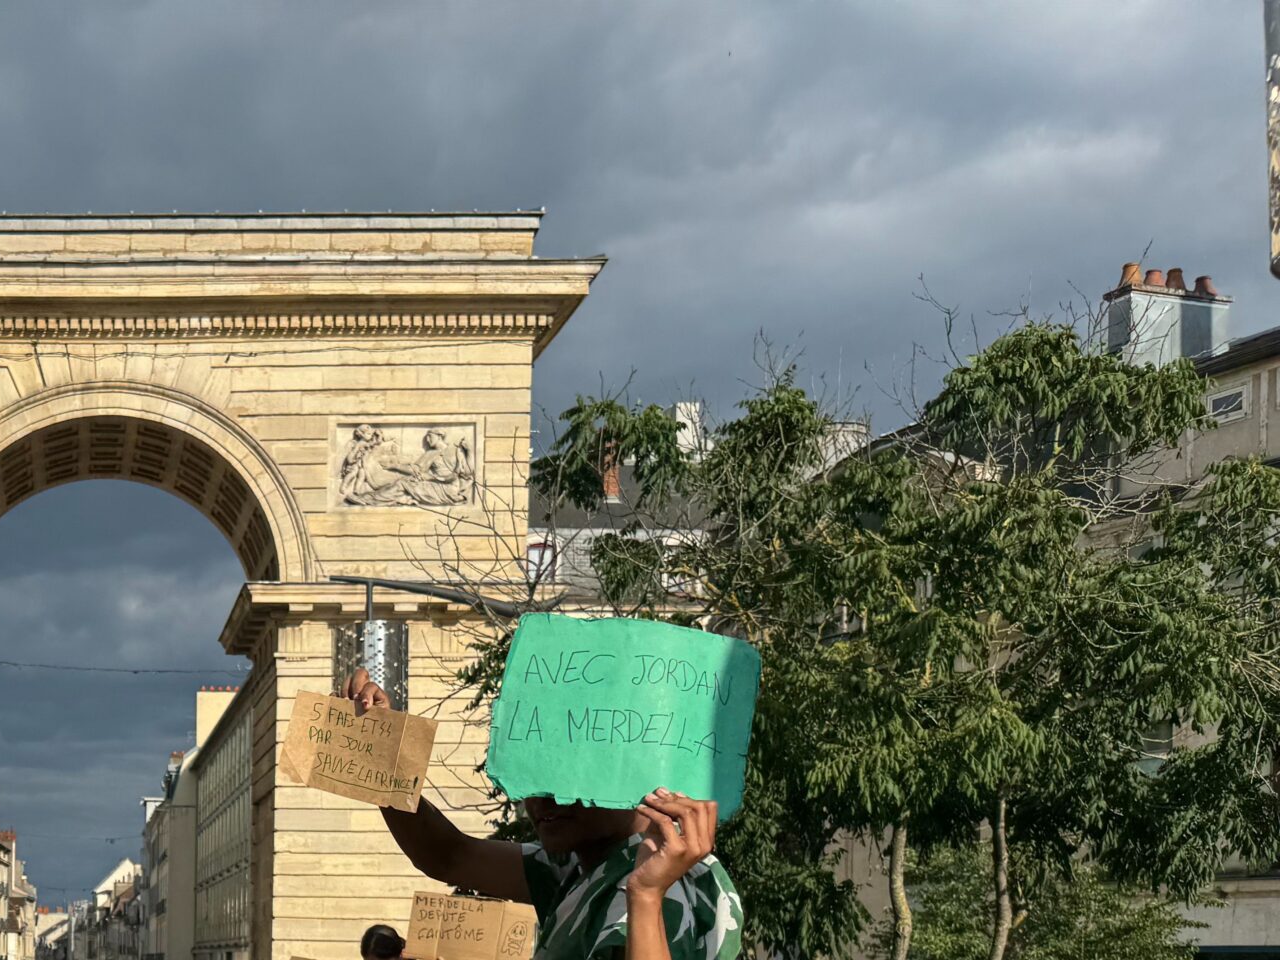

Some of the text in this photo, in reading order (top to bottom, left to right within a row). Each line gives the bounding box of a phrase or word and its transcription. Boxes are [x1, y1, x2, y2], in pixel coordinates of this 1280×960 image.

[524, 650, 733, 706] AVEC JORDAN
[308, 726, 373, 757] PAR JOUR
[507, 700, 722, 758] LA MERDELLA
[415, 895, 484, 913] MERDELLA
[417, 923, 485, 942] FANTÔME
